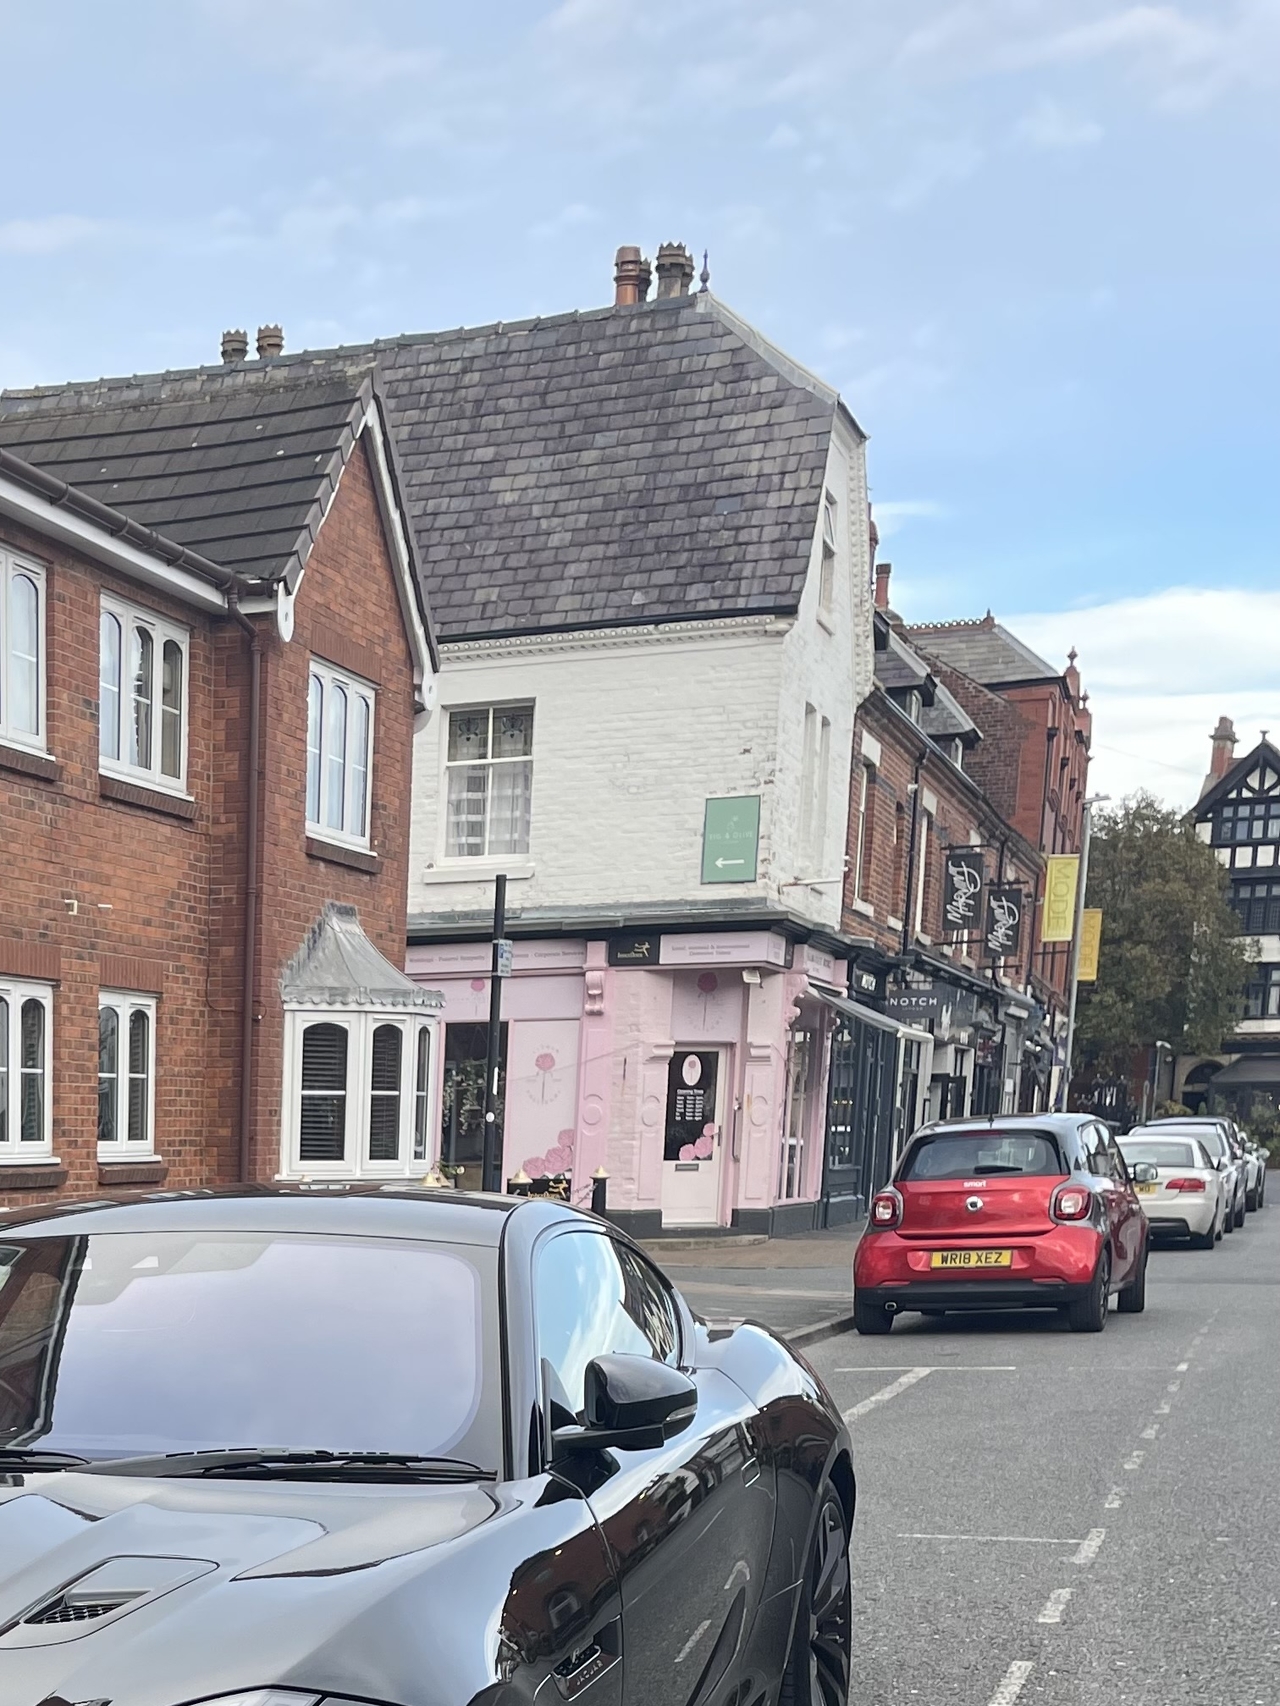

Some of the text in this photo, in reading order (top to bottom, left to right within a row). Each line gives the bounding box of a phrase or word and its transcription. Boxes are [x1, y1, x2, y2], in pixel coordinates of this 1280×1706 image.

[1049, 861, 1074, 930] MODE
[890, 997, 938, 1006] NOTCH
[963, 1180, 987, 1188] smart
[940, 1251, 1003, 1265] WR18 XEZ
